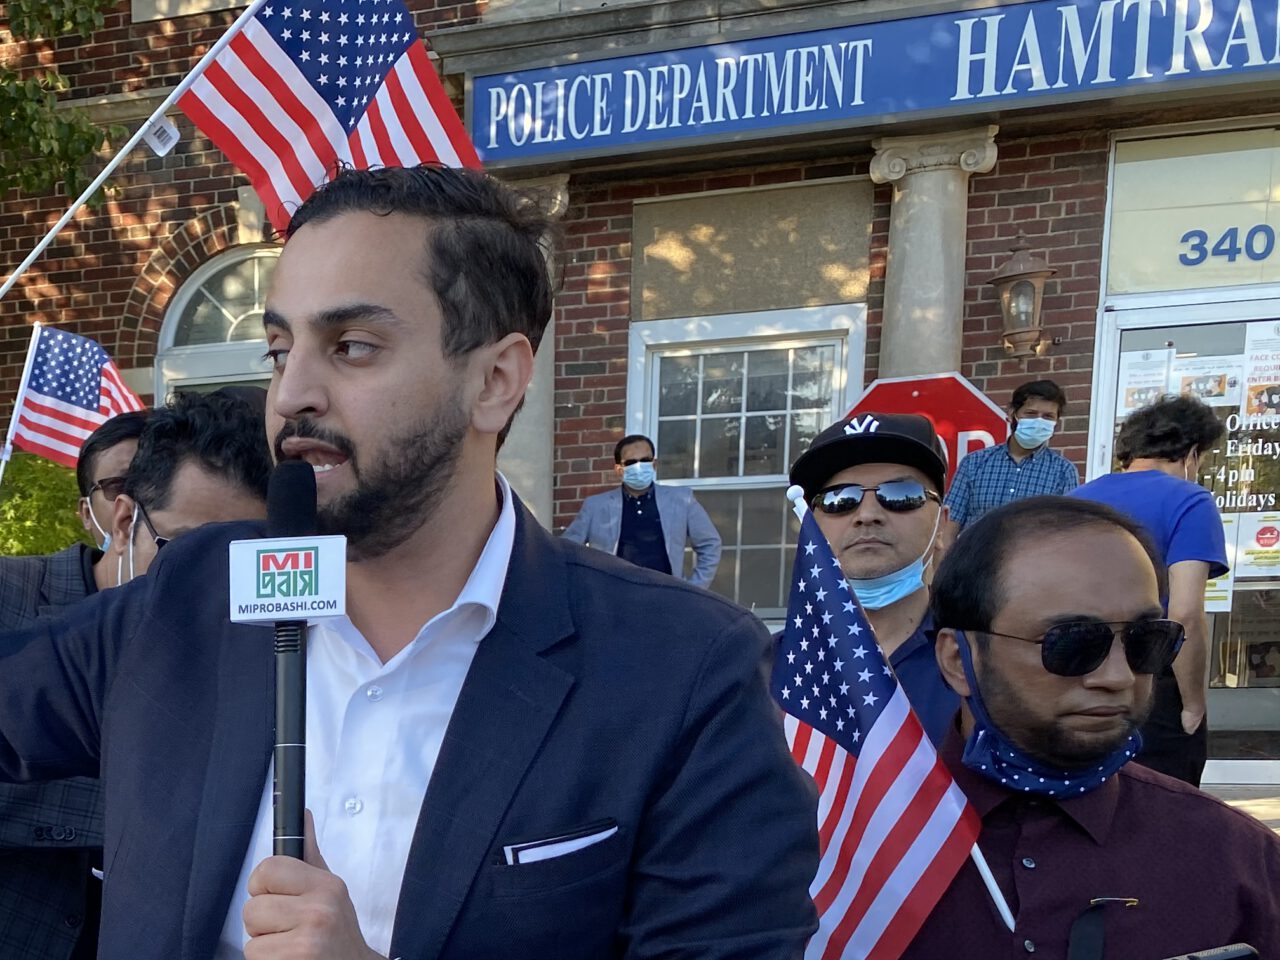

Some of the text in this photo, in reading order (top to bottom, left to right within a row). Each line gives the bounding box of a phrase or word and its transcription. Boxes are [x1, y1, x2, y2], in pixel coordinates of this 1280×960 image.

[950, 0, 1280, 101] HAMTRA
[486, 38, 873, 149] POLICE DEPARTMENT
[1178, 224, 1275, 266] 340
[1225, 438, 1280, 459] Friday
[1211, 489, 1276, 511] olidays
[262, 552, 313, 571] MI
[238, 600, 337, 614] MIPROBASHI.COM
